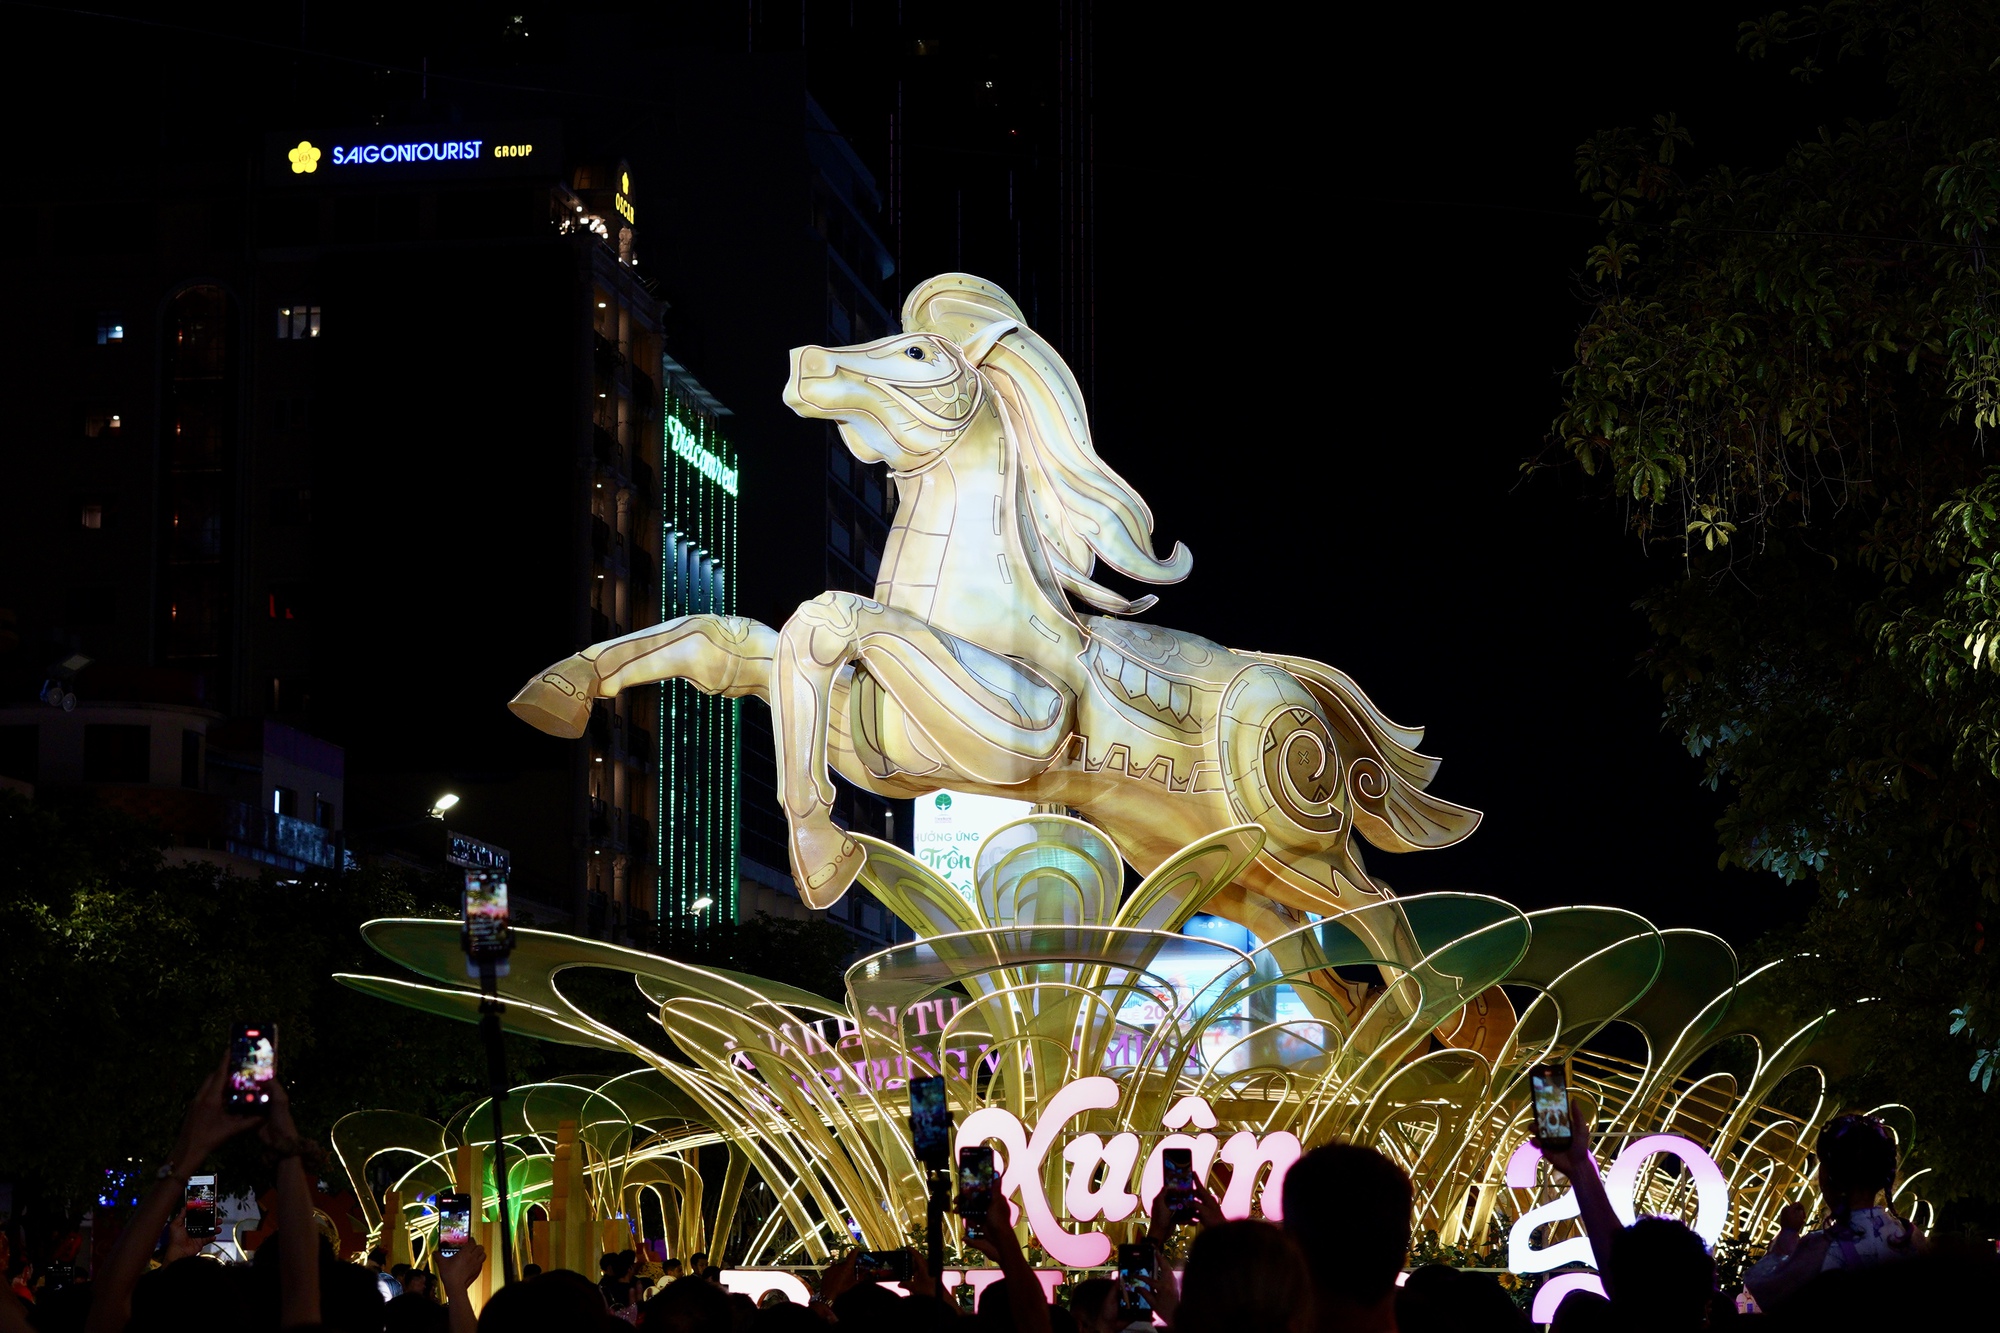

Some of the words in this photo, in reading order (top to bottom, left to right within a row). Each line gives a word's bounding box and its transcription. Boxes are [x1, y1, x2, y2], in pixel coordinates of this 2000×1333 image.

[333, 141, 483, 165] SAIGONTOURIST
[494, 144, 533, 158] GROUP
[615, 192, 635, 225] OSCAR
[955, 830, 980, 842] ỨNG
[919, 845, 973, 870] Trồn
[1144, 1005, 1188, 1021] 206
[955, 1076, 1302, 1267] Xuân
